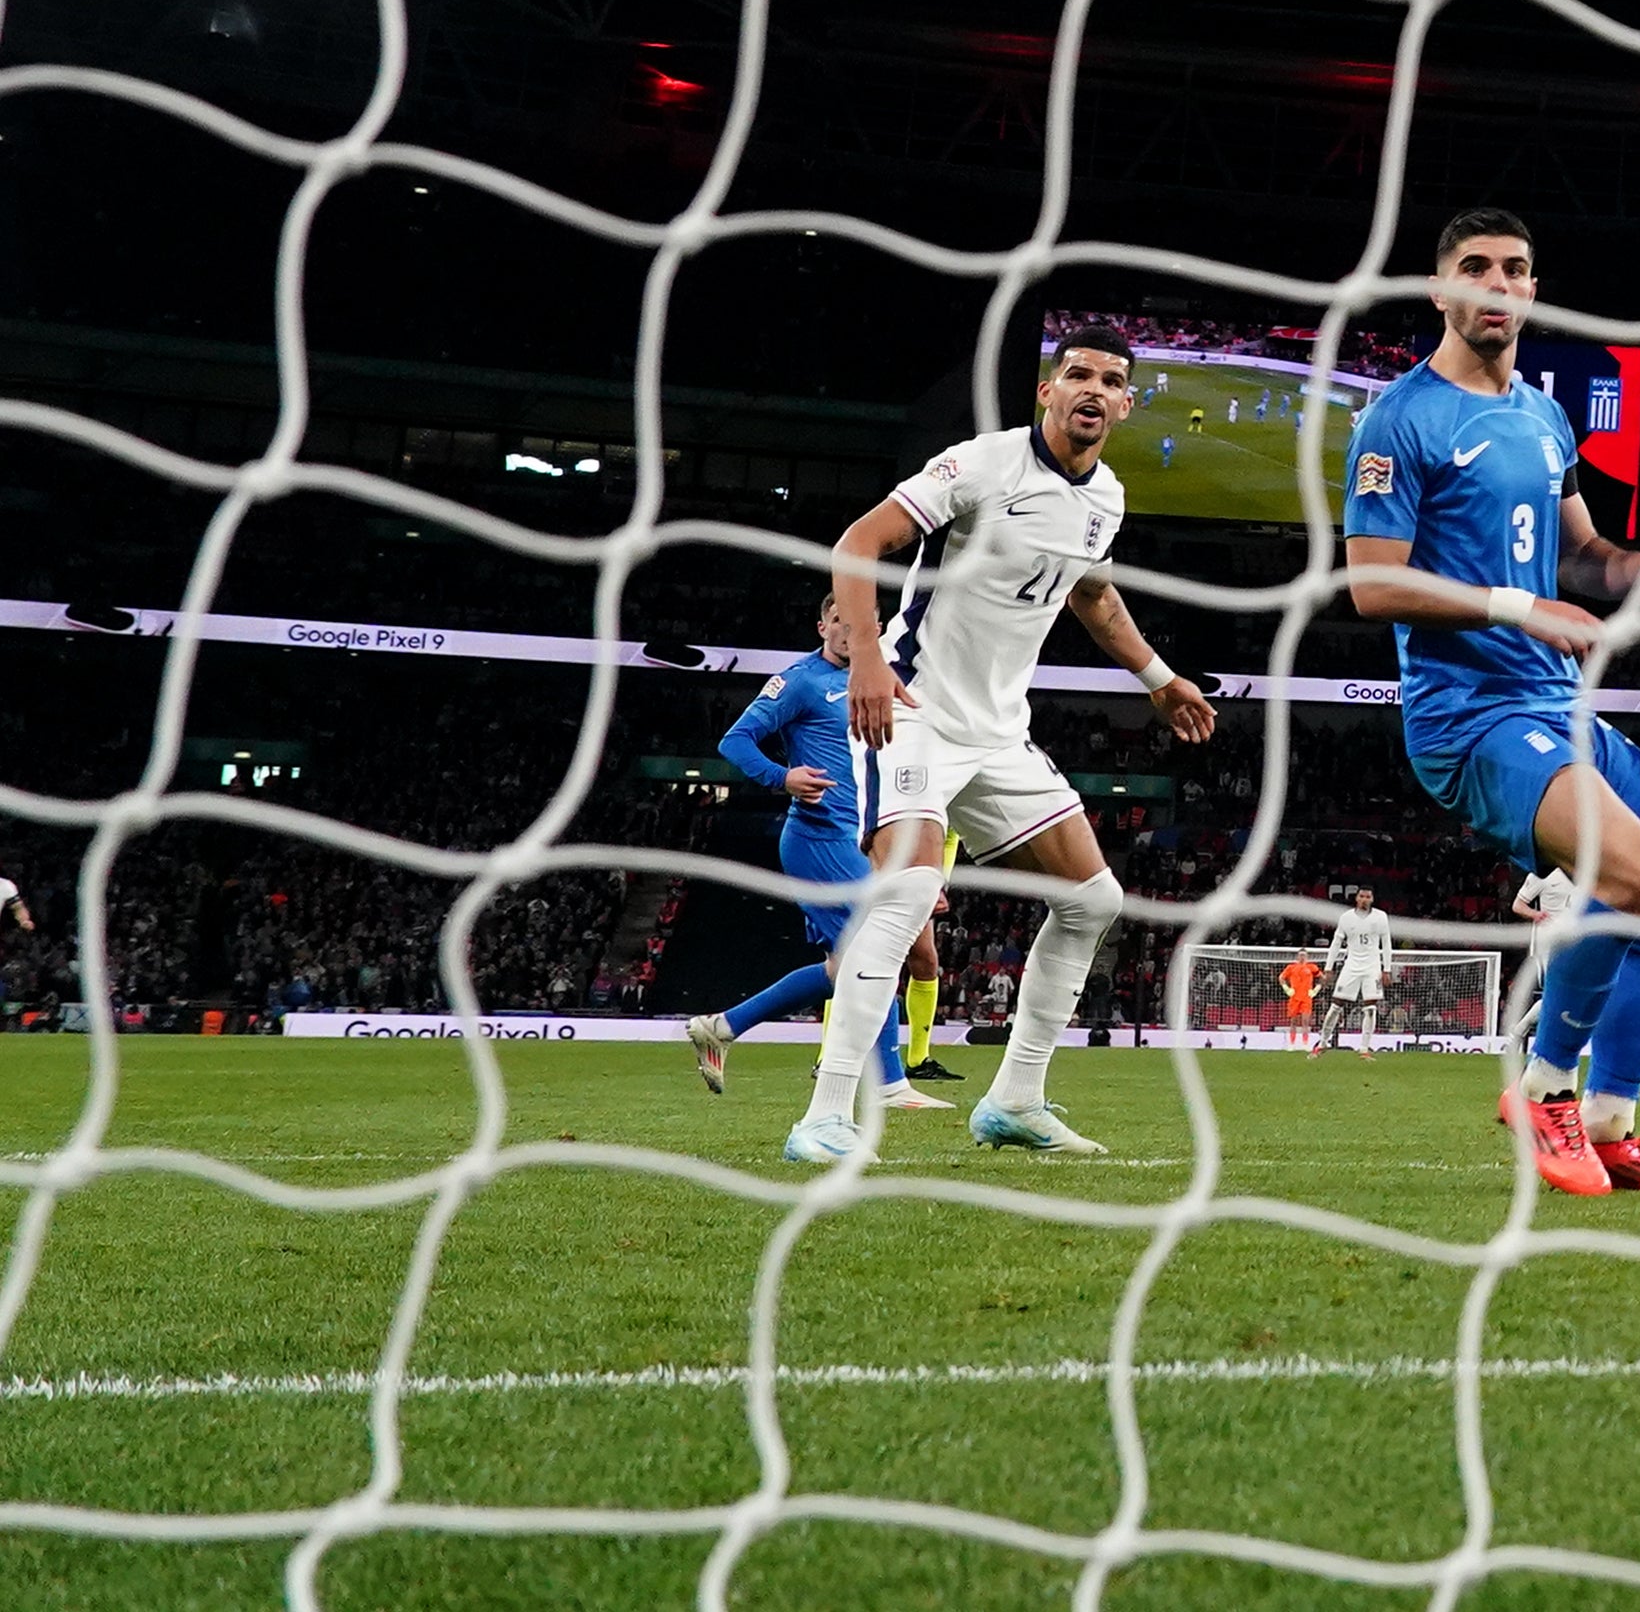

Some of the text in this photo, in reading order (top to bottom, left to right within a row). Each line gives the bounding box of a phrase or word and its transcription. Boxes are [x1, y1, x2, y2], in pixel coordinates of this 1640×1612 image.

[1512, 503, 1535, 563] 3
[1015, 554, 1068, 606] 21
[288, 624, 445, 650] Google Pixel 9
[1344, 683, 1400, 705] Googl
